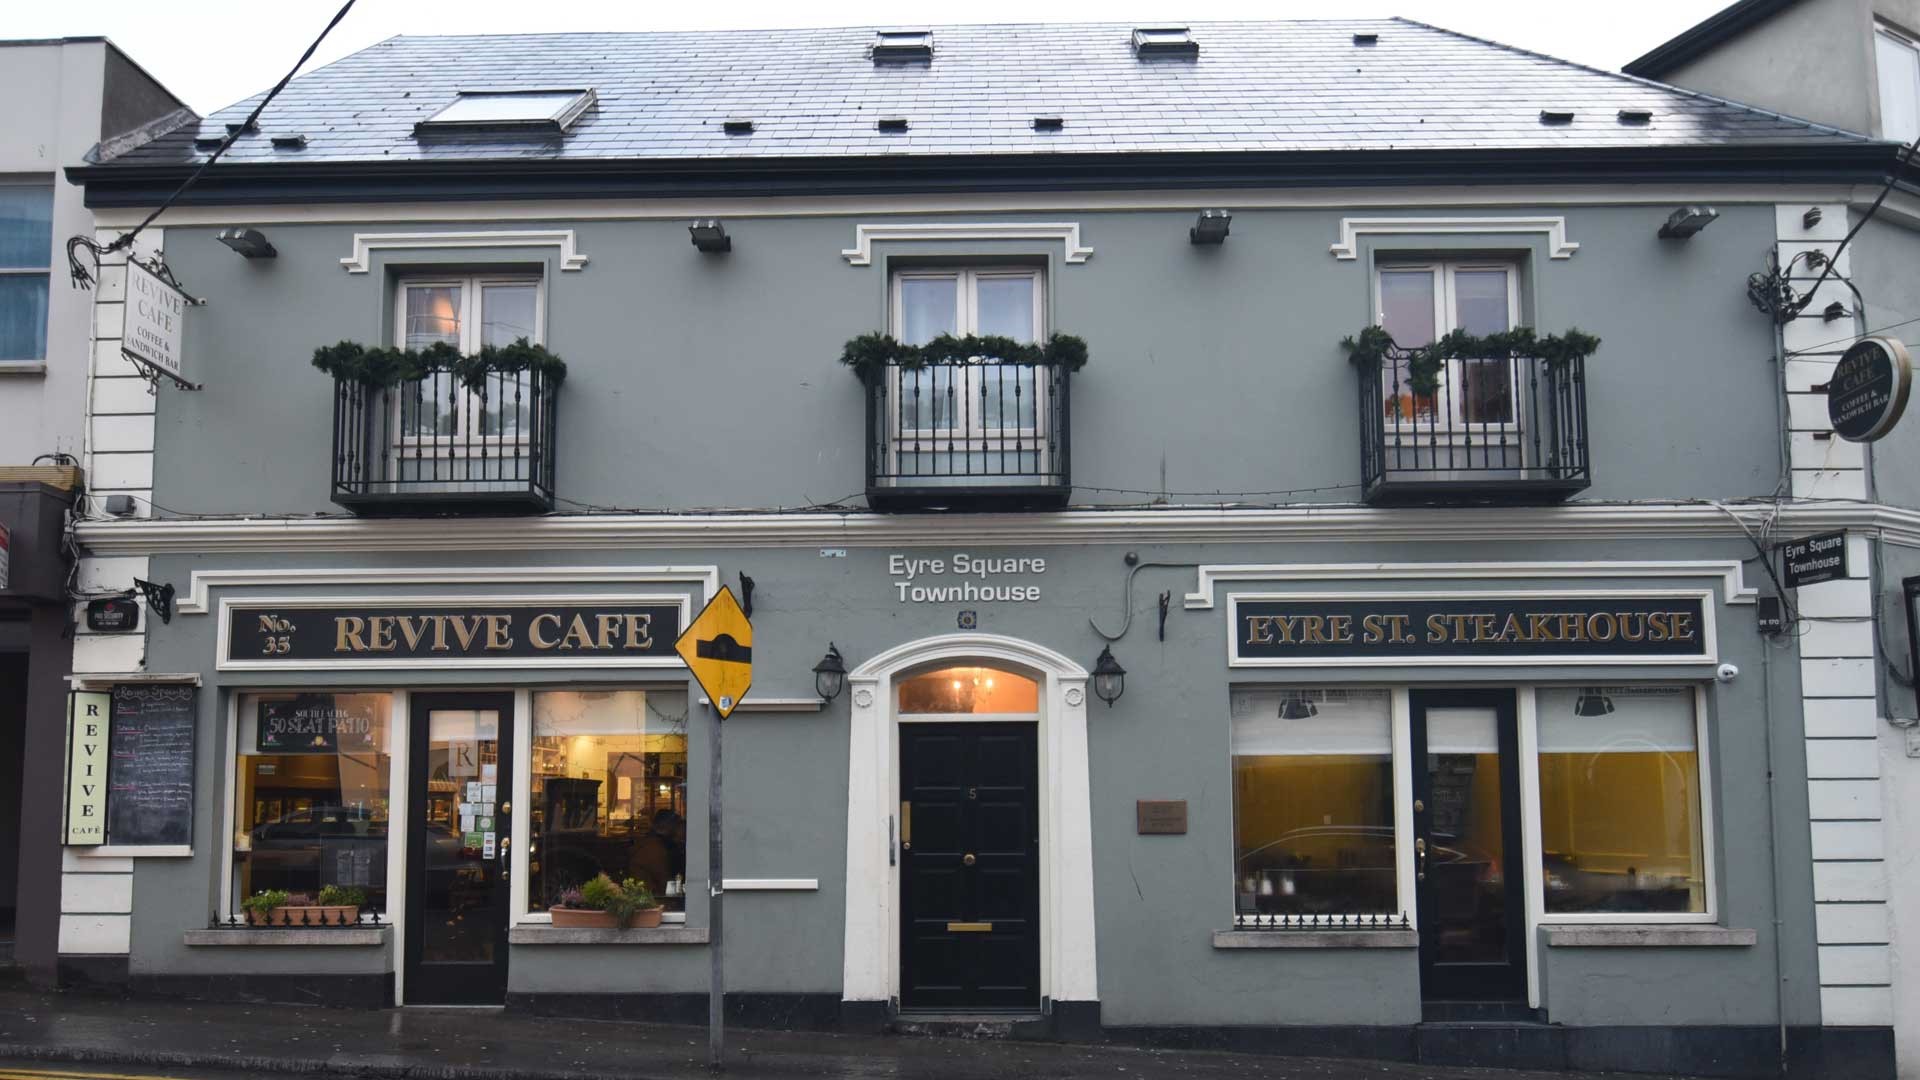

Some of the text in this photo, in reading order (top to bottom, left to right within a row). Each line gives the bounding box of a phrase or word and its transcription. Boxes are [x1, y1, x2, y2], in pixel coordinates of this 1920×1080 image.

[138, 299, 172, 333] CAFE
[137, 326, 170, 353] COFFEE &
[165, 356, 179, 371] BAR
[1841, 393, 1869, 411] COFFEE
[1873, 394, 1889, 408] BAR
[1785, 537, 1842, 559] Eyre Square
[888, 553, 1046, 580] Eyre Square
[1789, 556, 1840, 575] Townhouse
[894, 581, 1041, 603] Townhouse
[258, 614, 297, 633] No.
[333, 612, 653, 652] REVIVE CAFE
[1245, 611, 1696, 645] EYRE ST. STEAKHOUSE
[262, 635, 291, 655] 35
[270, 717, 370, 734] 50 SEAT PATIO
[81, 703, 100, 817] REVIVE
[455, 741, 475, 768] R
[969, 788, 977, 800] 5
[72, 825, 101, 835] CAFÉ
